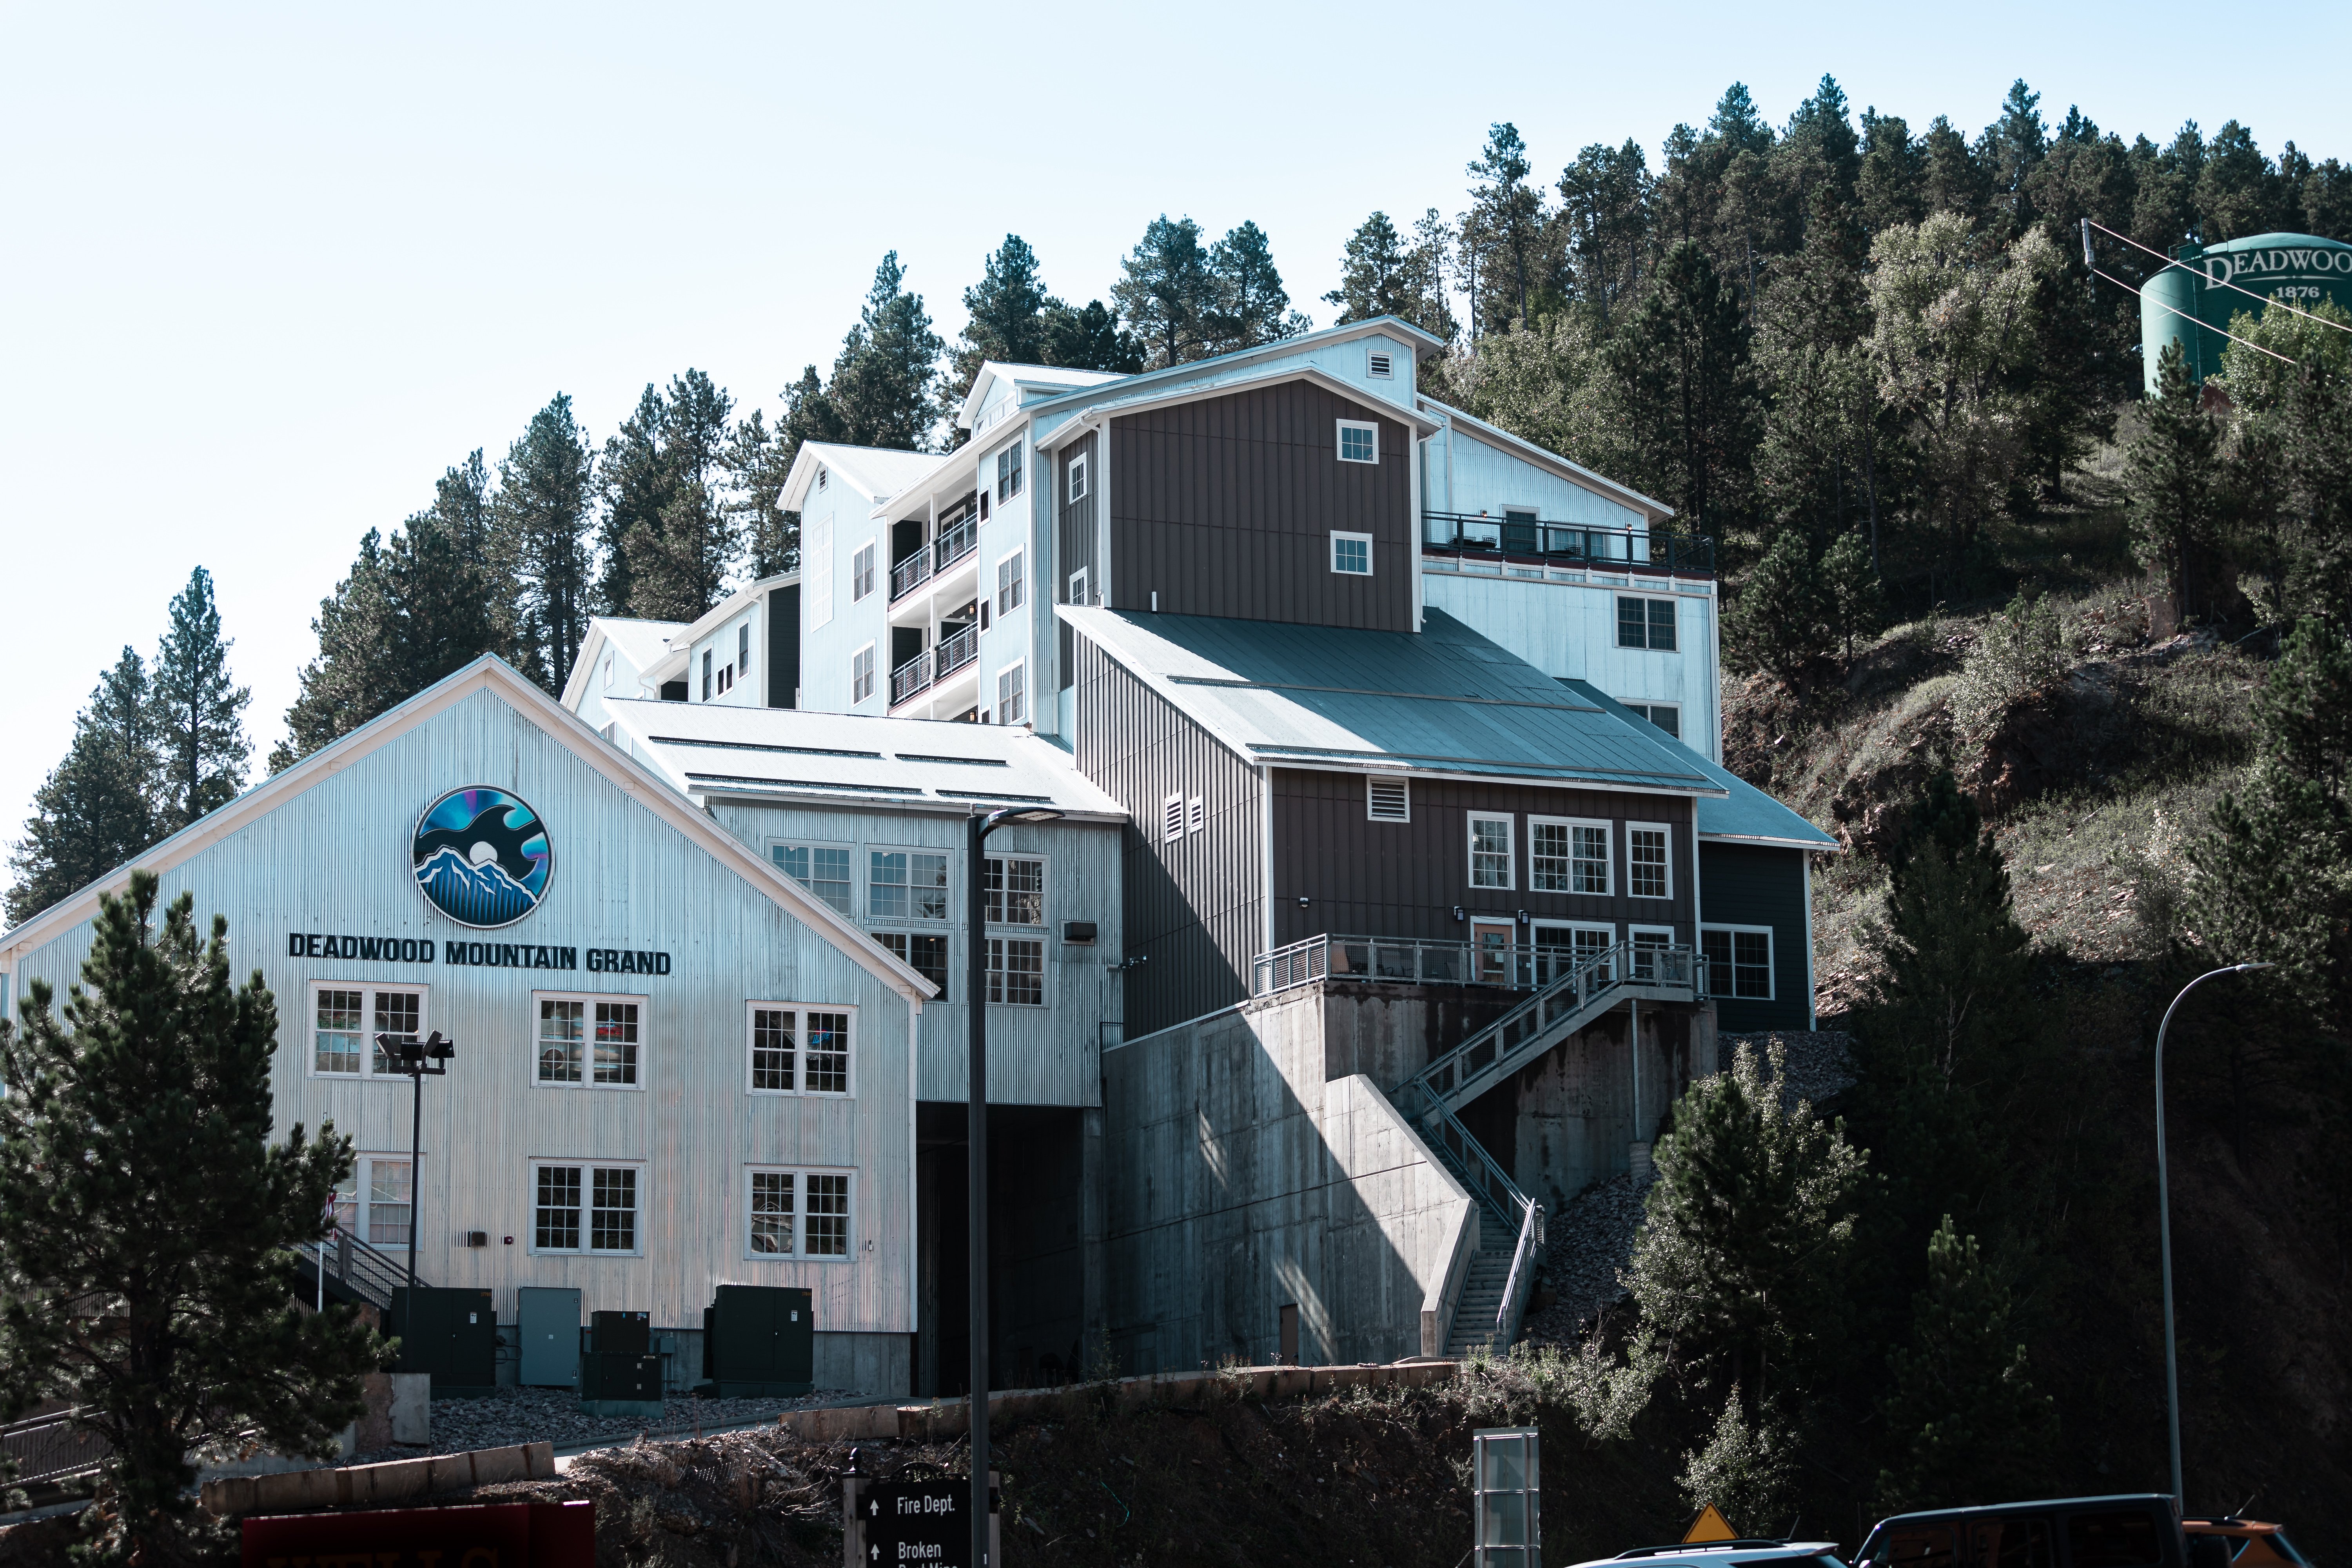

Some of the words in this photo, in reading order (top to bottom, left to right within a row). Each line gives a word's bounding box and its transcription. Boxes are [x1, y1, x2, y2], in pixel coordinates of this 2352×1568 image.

[2276, 286, 2320, 298] 1876
[289, 933, 435, 962] DEADWOOD
[446, 940, 577, 970] MOUNTAIN
[587, 948, 671, 975] GRAND
[898, 1497, 920, 1514] Fire
[924, 1494, 955, 1516] Dept.
[898, 1541, 941, 1559] Broken
